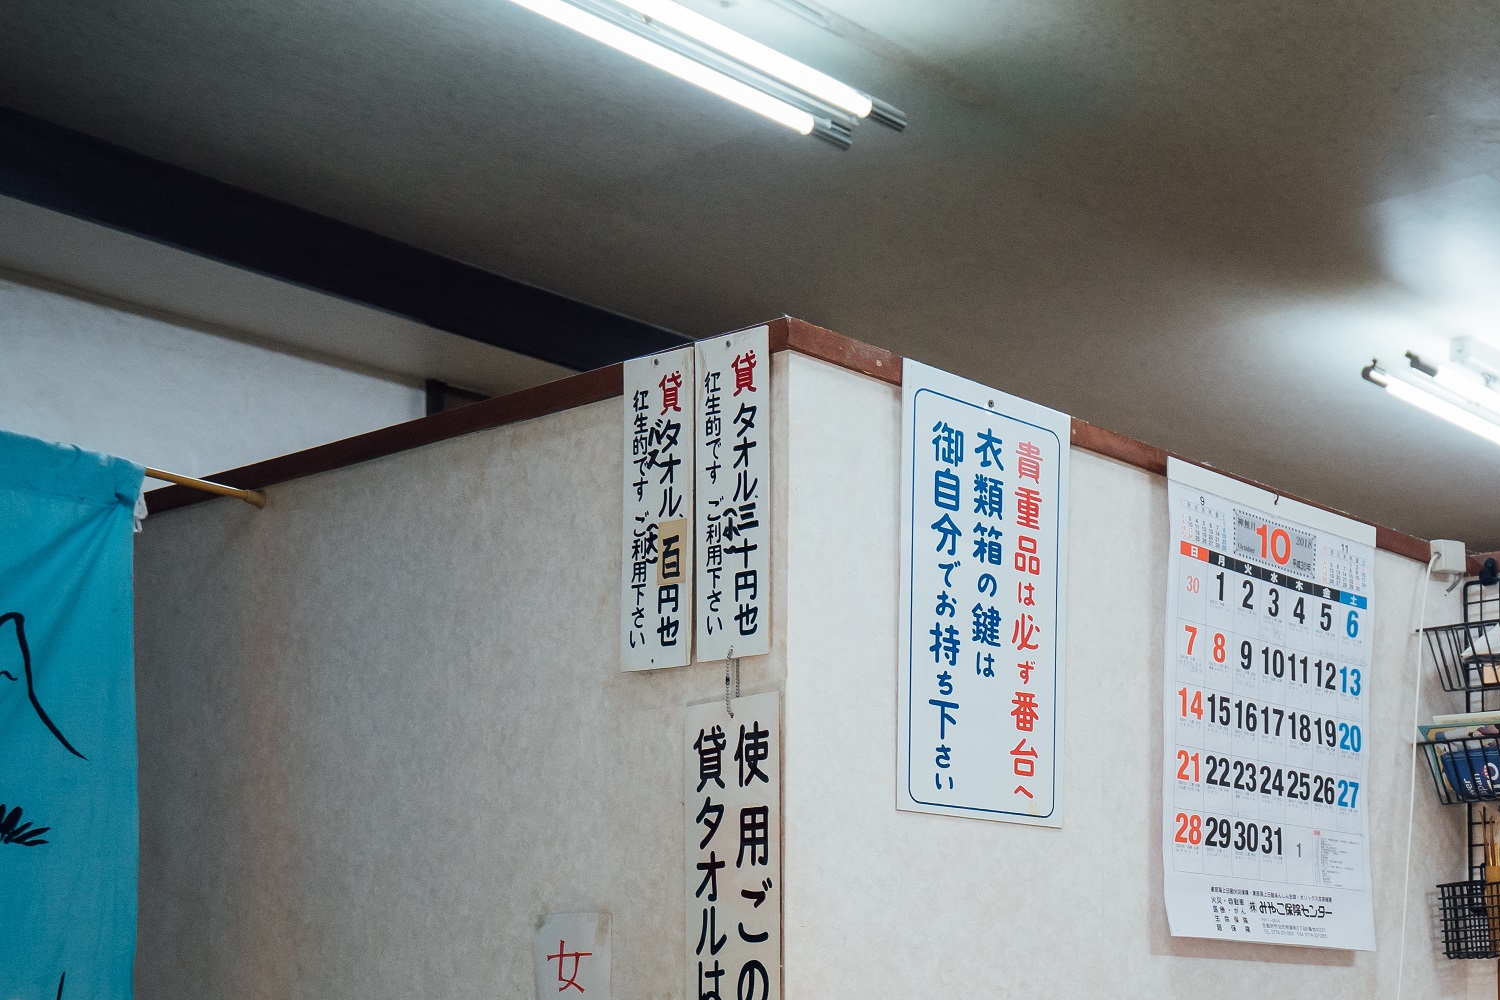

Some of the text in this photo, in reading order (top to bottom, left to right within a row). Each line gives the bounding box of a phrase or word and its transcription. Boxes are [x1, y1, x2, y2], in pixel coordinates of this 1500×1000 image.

[706, 496, 724, 635] ご利用下さい
[971, 427, 1005, 679] 衣類箱の鍵は
[1256, 523, 1292, 565] 10
[1295, 535, 1313, 550] 2018
[928, 420, 965, 792] 御自分でお持ち下さい
[1186, 572, 1359, 638] 30 1 2 3 4 5 6
[1190, 546, 1358, 606] 日 月 火 水 木 金 土
[1009, 440, 1044, 799] 貴重品は必ず番台へ
[1184, 625, 1361, 697] 7 8 9 10 11 12 13
[1178, 687, 1361, 752] 14 15 16 17 18 19 20
[1177, 750, 1359, 808] 21 22 23 24 25 26 27
[1175, 812, 1302, 857] 28 29 30 31 1
